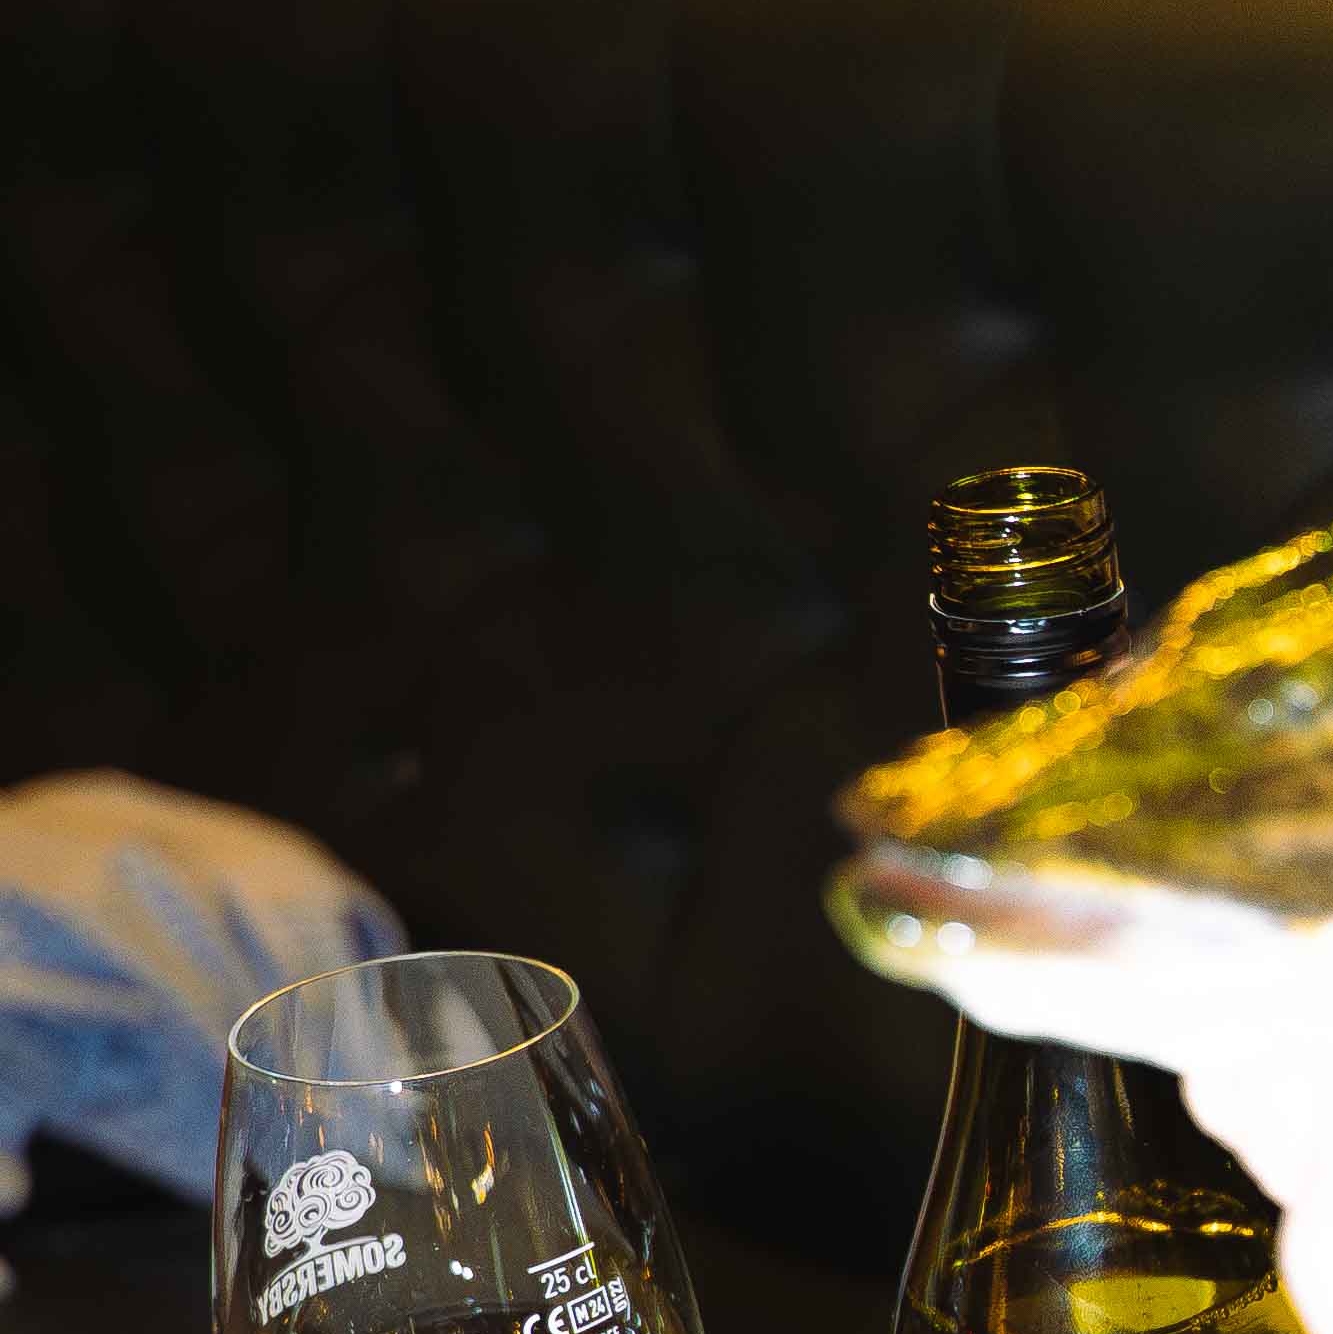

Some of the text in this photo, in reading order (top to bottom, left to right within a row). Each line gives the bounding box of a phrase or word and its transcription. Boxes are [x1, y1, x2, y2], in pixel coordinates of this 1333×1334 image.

[540, 1255, 598, 1299] 25 cl
[607, 1276, 628, 1313] 0122
